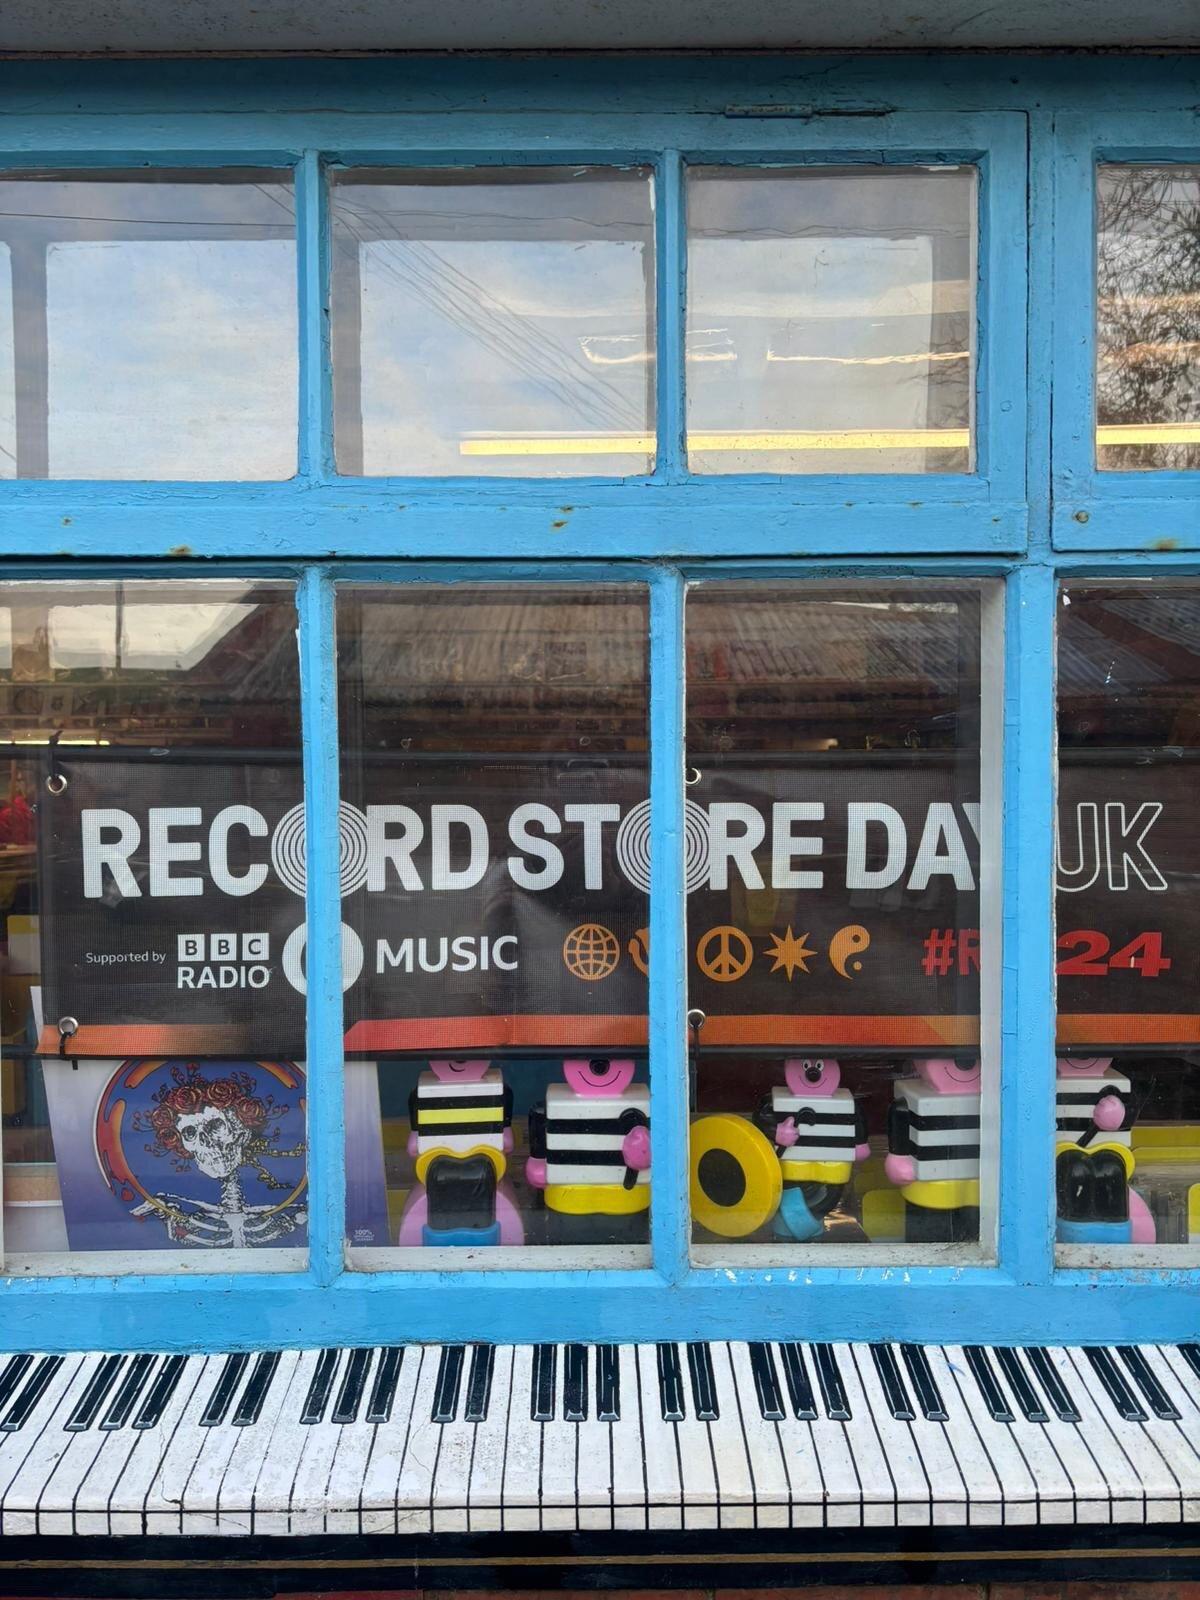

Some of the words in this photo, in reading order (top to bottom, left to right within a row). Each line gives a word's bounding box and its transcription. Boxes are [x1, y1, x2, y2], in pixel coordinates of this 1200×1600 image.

[81, 800, 489, 899] RECORD
[507, 798, 824, 894] STORE
[845, 802, 980, 890] DA
[86, 952, 149, 965] Supported
[152, 950, 166, 963] by
[180, 935, 266, 959] BBC
[376, 935, 518, 974] MUSIC
[177, 965, 270, 989] RADIO
